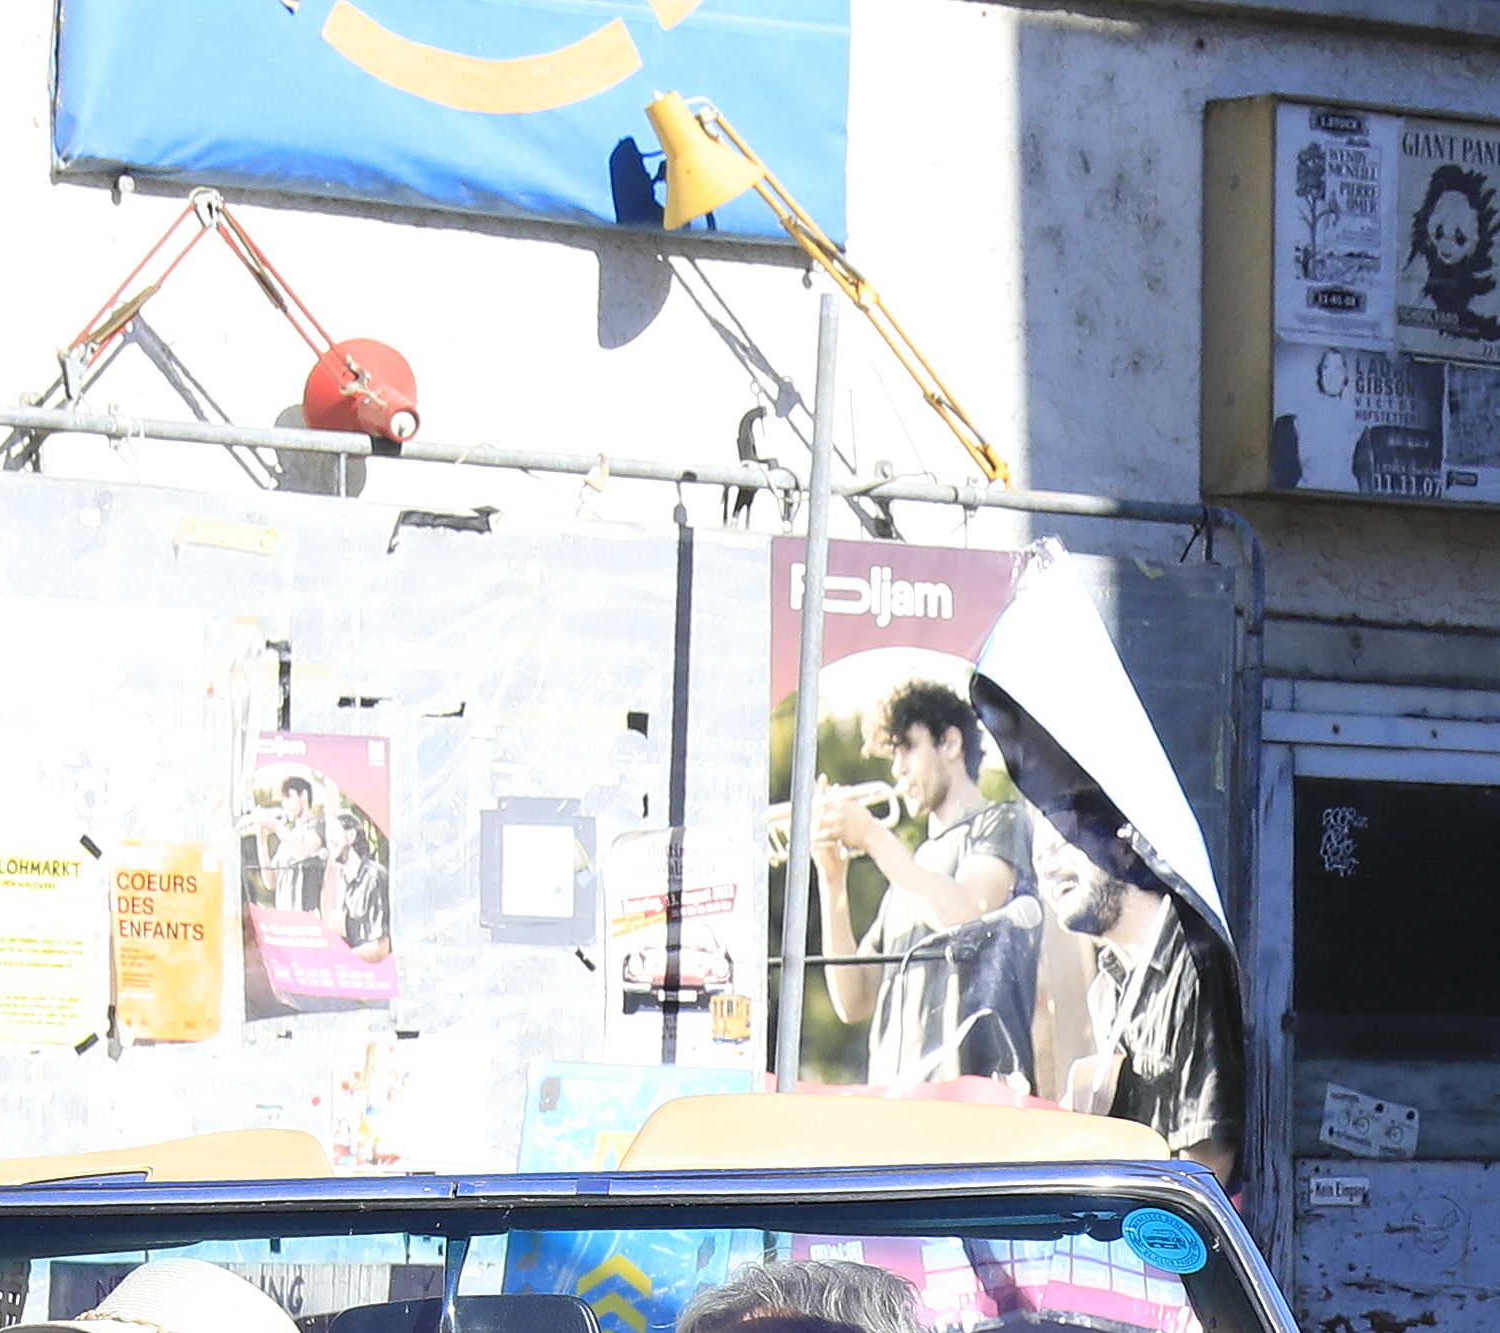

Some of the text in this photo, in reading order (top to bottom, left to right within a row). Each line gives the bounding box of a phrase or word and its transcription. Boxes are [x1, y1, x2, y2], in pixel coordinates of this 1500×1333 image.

[1402, 131, 1453, 159] GIANT
[1355, 377, 1415, 397] GIBSON
[117, 872, 197, 894] COEURS
[118, 896, 155, 915] DES
[119, 920, 205, 941] ENFANTS
